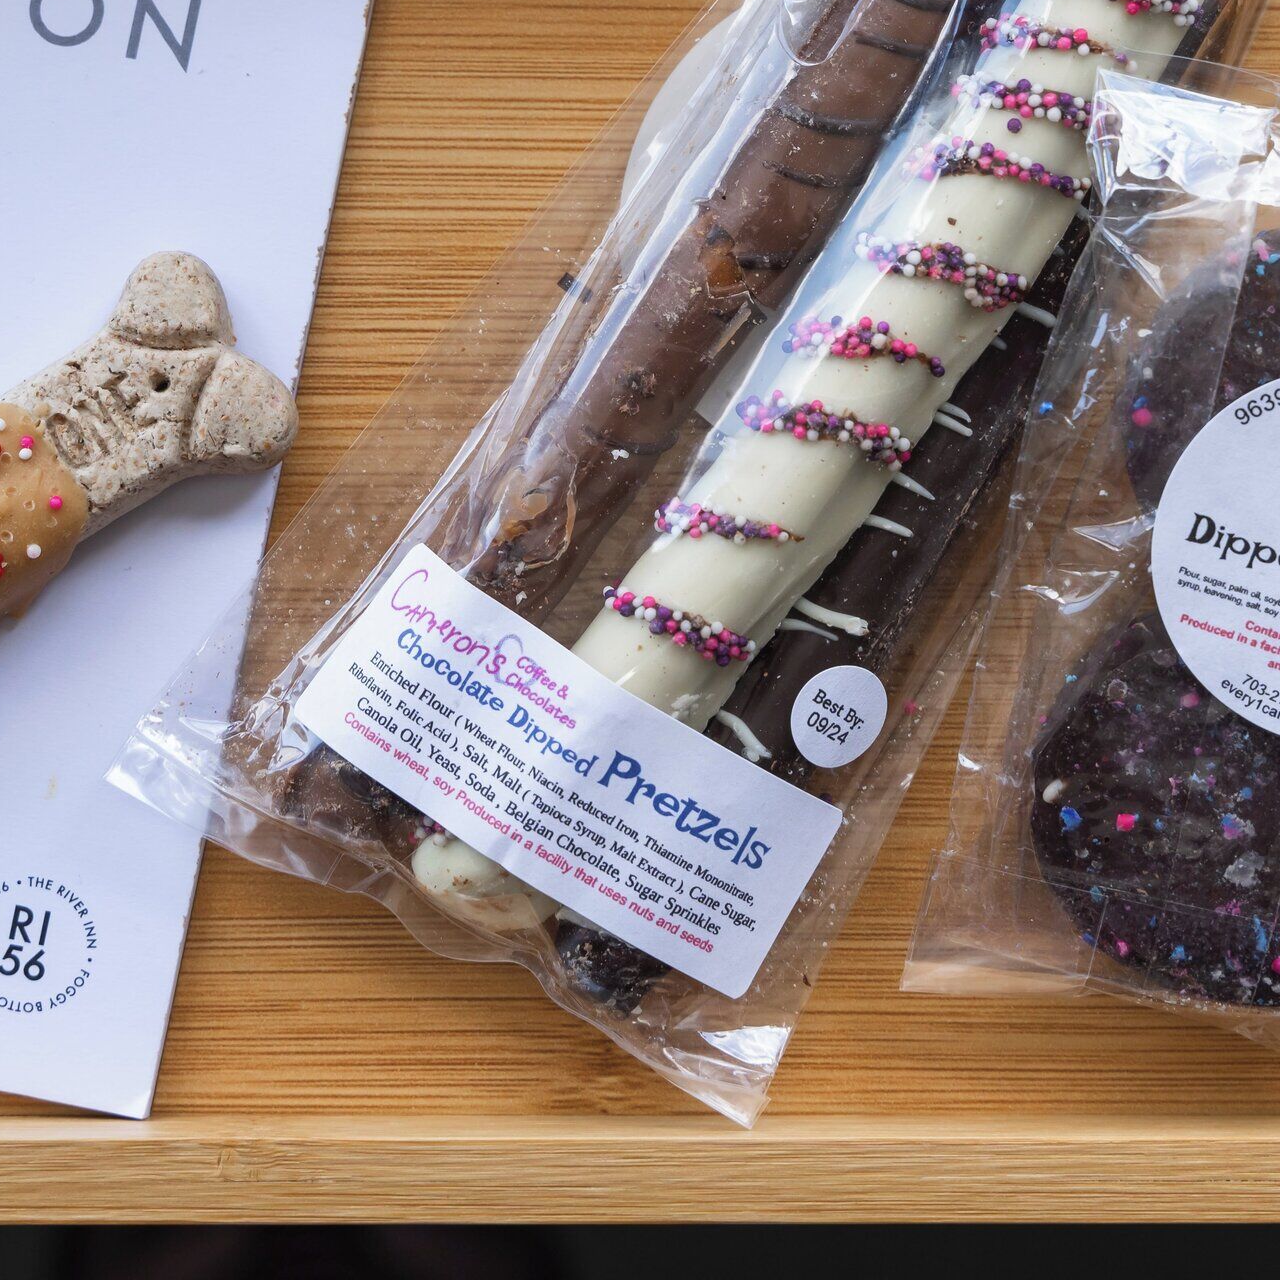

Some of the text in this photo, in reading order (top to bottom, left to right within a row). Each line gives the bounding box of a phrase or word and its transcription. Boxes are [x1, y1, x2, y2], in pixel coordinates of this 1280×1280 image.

[1180, 614, 1235, 639] Produced
[1237, 633, 1248, 644] in
[1250, 639, 1257, 647] a
[516, 655, 569, 700] Coffee &
[505, 671, 577, 730] Chocolates
[812, 689, 864, 730] Best By:
[397, 628, 771, 869] Chocolate Dipped Pretzels
[807, 711, 849, 746] 09/24
[344, 712, 713, 953] Contains wheat, soy Produced in a facility that uses nuts and seeds
[357, 697, 398, 734] Canola
[400, 728, 423, 753] Oil,
[427, 744, 461, 780] Yeast,
[504, 800, 554, 841] Belgian
[556, 834, 620, 882] Chocolate,
[625, 874, 664, 904] Sugar
[664, 897, 721, 935] Sprinkles
[8, 904, 51, 946] RI
[28, 876, 97, 949] THE RIVER INN
[49, 969, 90, 1009] FOGGY
